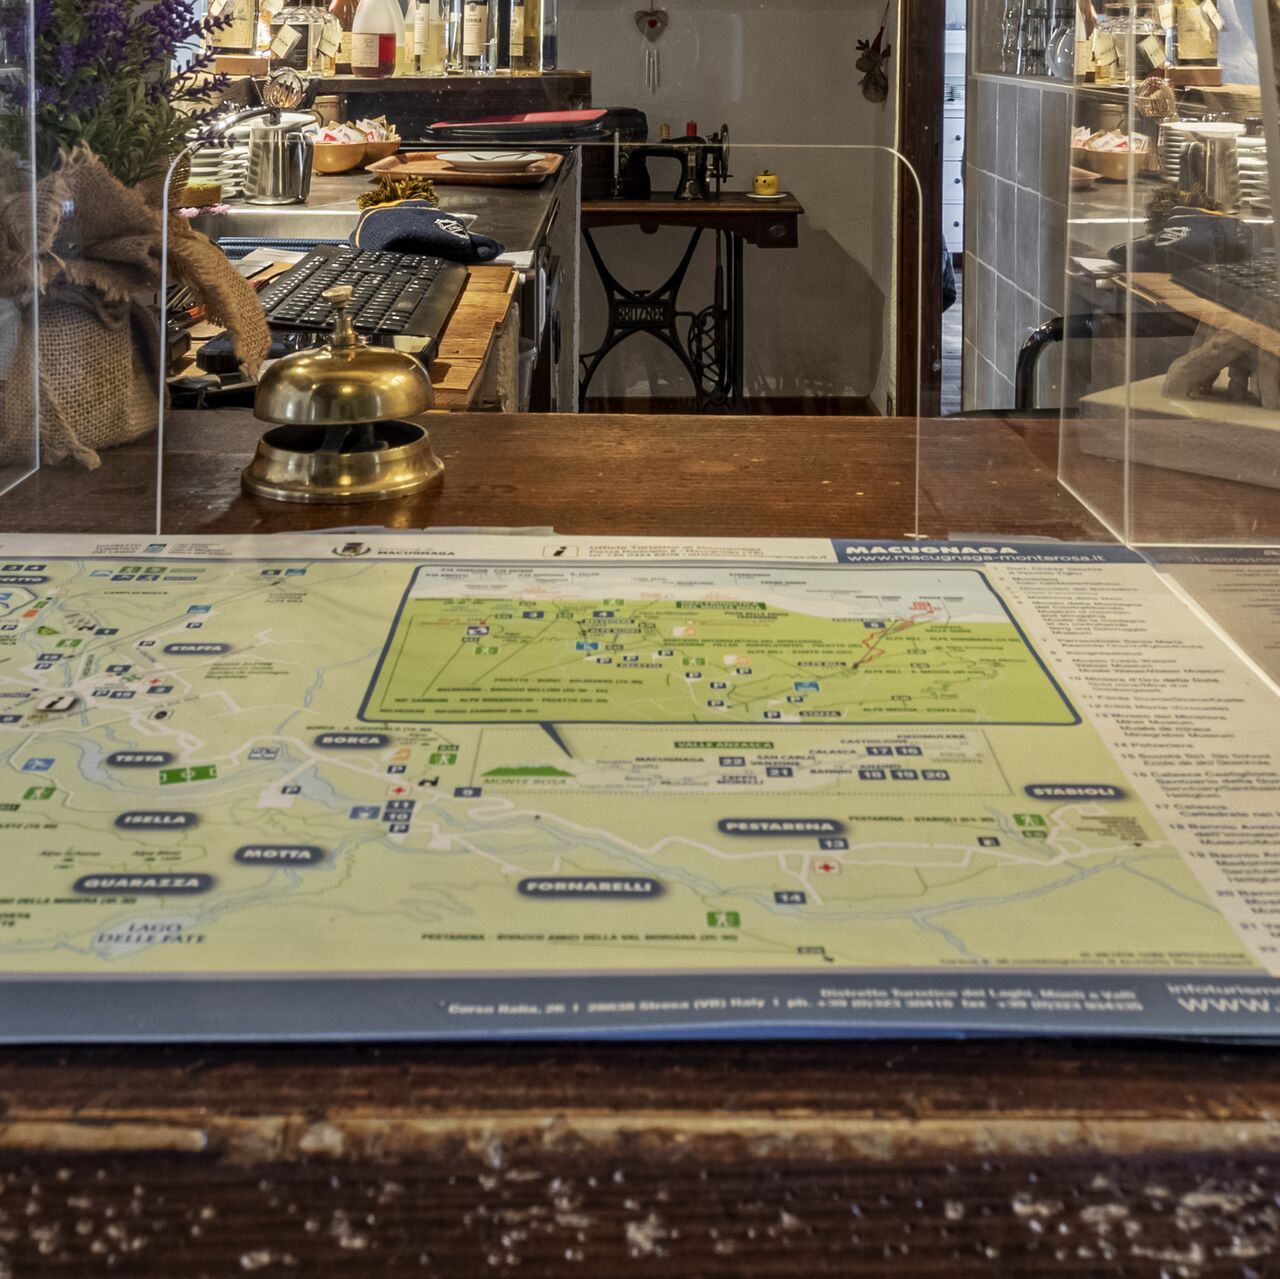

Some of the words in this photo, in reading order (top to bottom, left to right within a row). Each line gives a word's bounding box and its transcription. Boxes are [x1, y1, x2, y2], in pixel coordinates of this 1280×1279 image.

[846, 545, 1019, 554] MACUGNAGA
[848, 554, 1106, 563] www.macugnaga-monterosa.it
[322, 736, 380, 744] BORCA
[115, 755, 164, 763] TESTA
[771, 768, 789, 776] 21
[124, 815, 185, 824] ISELLA
[726, 822, 835, 832] PESTARENA
[828, 840, 844, 848] 13
[244, 850, 311, 859] MOTTA
[85, 878, 199, 888] QUARAZZA
[526, 882, 652, 892] FORNARELLI
[780, 894, 802, 902] 14
[129, 924, 182, 932] LAGO
[97, 934, 157, 944] DELLE
[162, 934, 206, 944] FATE
[639, 1000, 690, 1011] Stresa
[730, 997, 765, 1009] Italy
